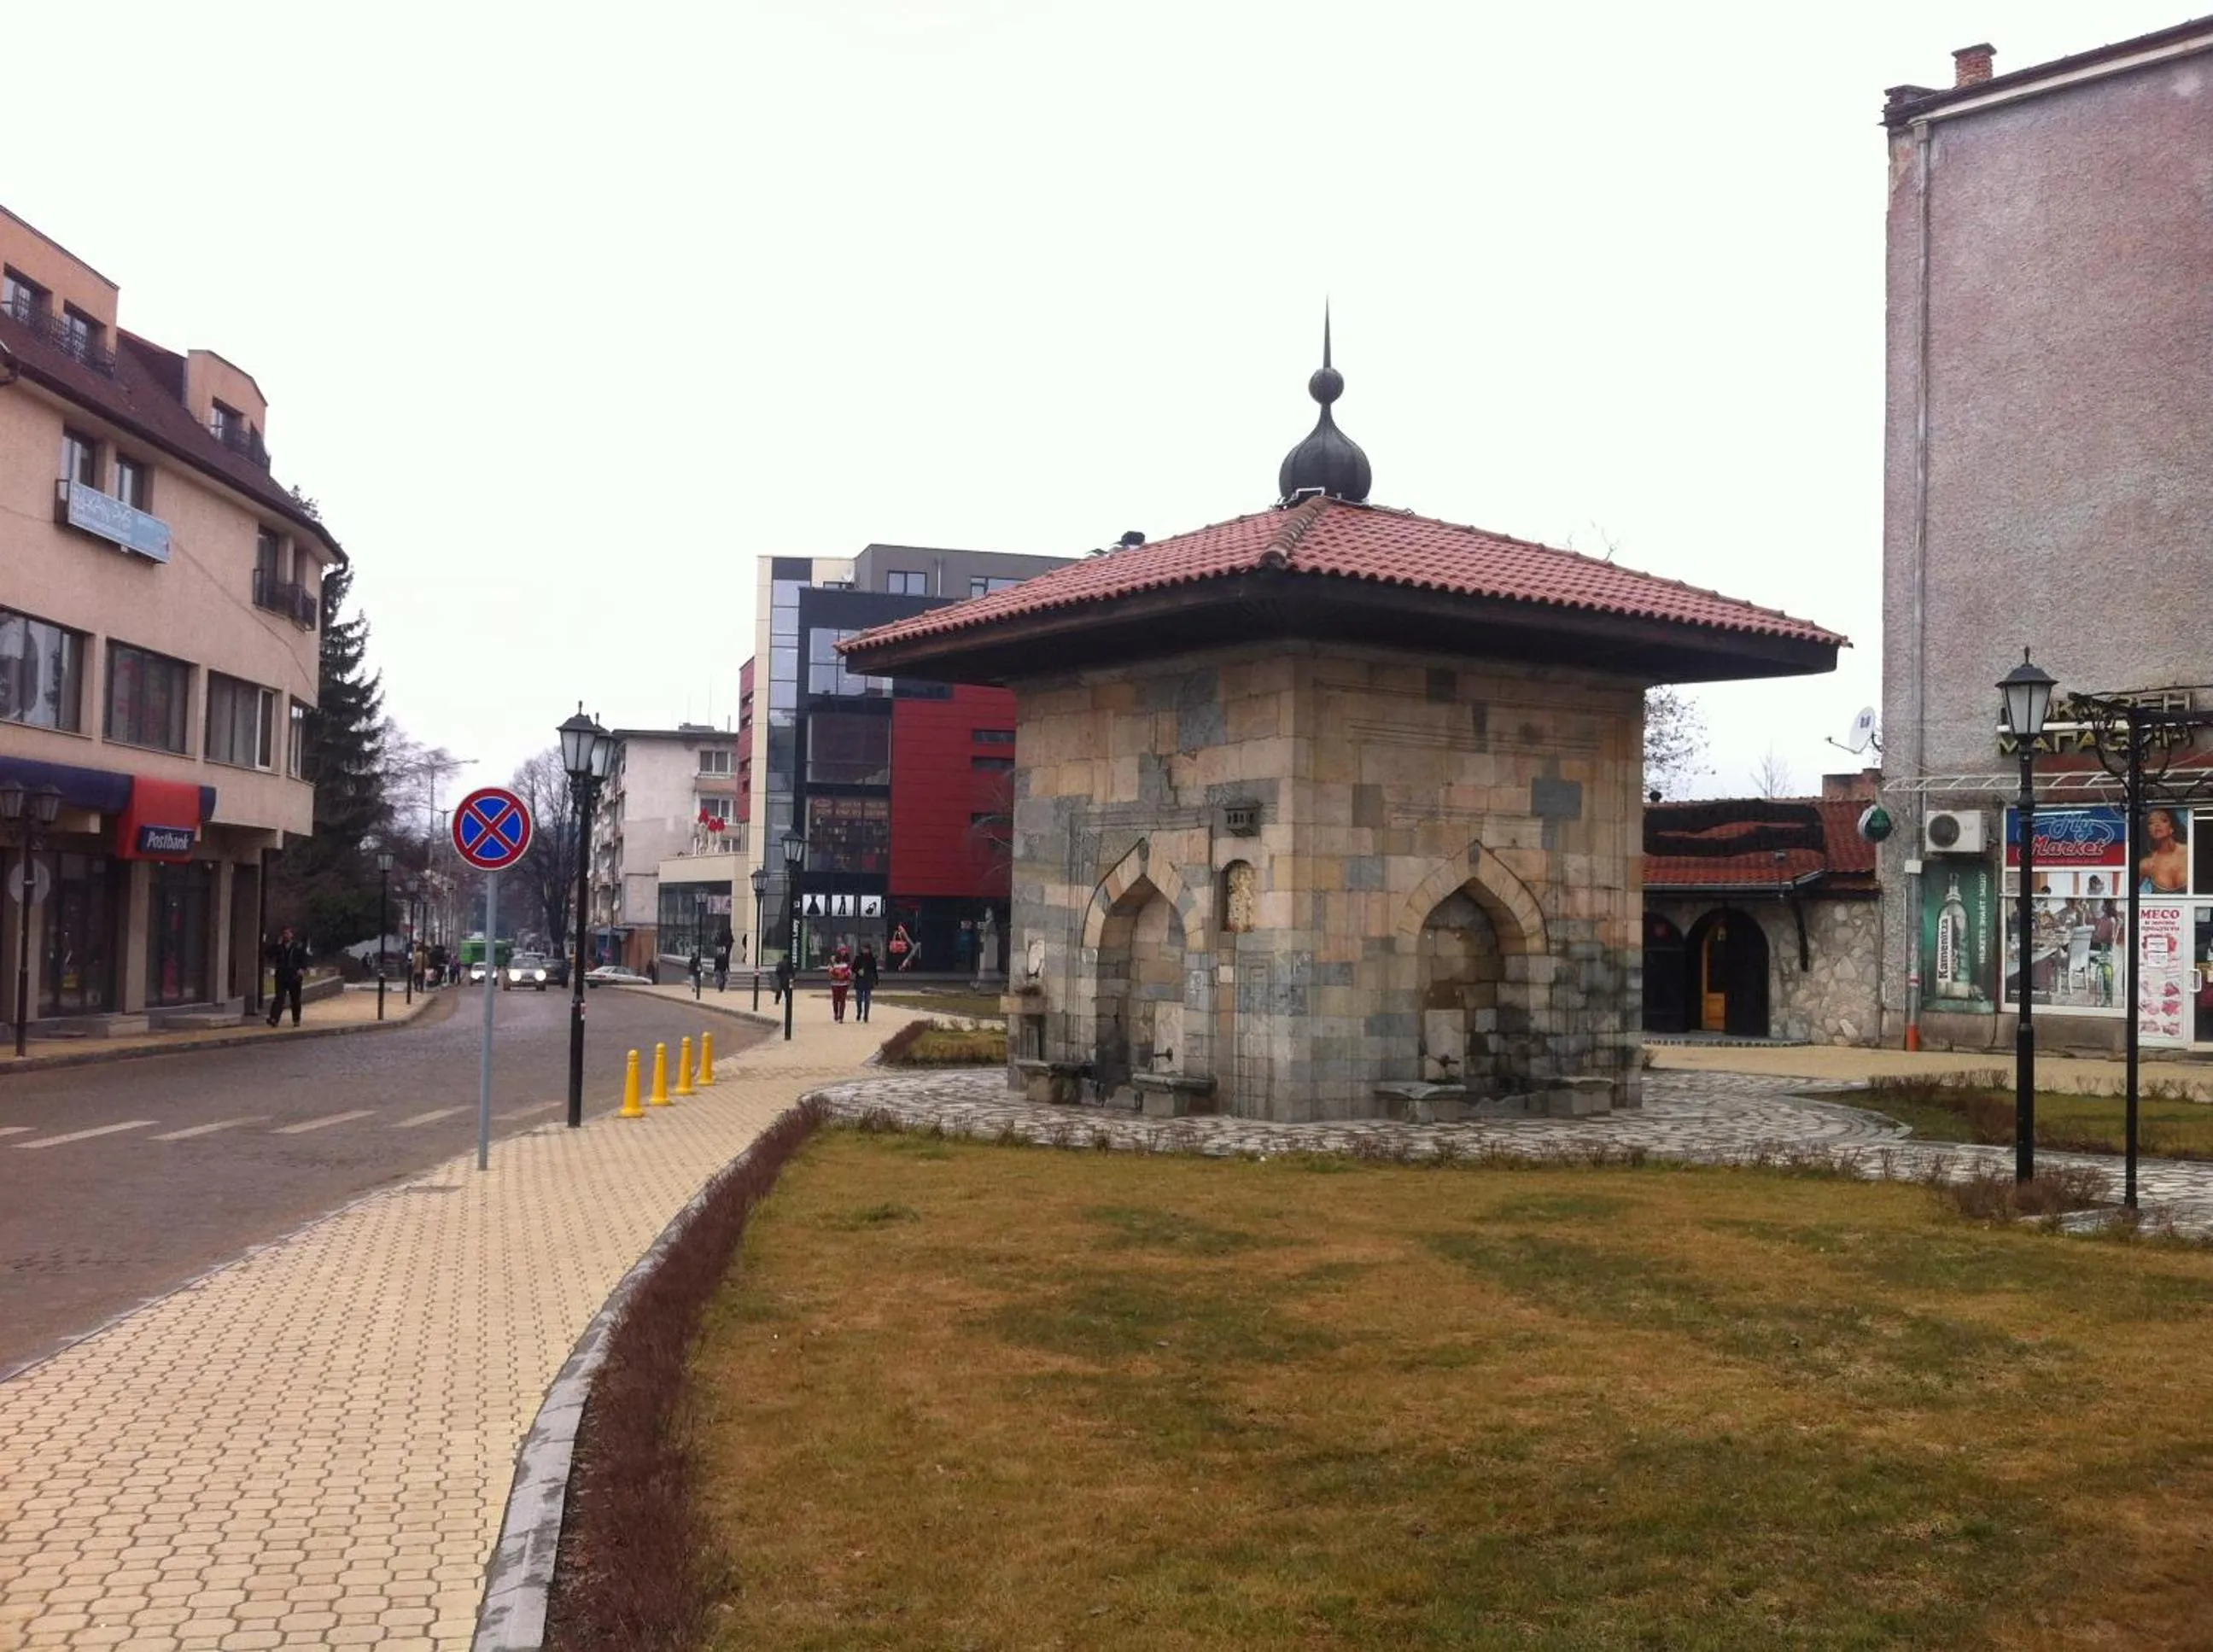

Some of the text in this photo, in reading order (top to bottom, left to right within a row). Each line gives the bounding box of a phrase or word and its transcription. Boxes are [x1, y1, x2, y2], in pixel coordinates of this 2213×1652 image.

[146, 831, 190, 850] Postbank
[2032, 834, 2105, 856] Market
[2140, 909, 2180, 919] МЕСО
